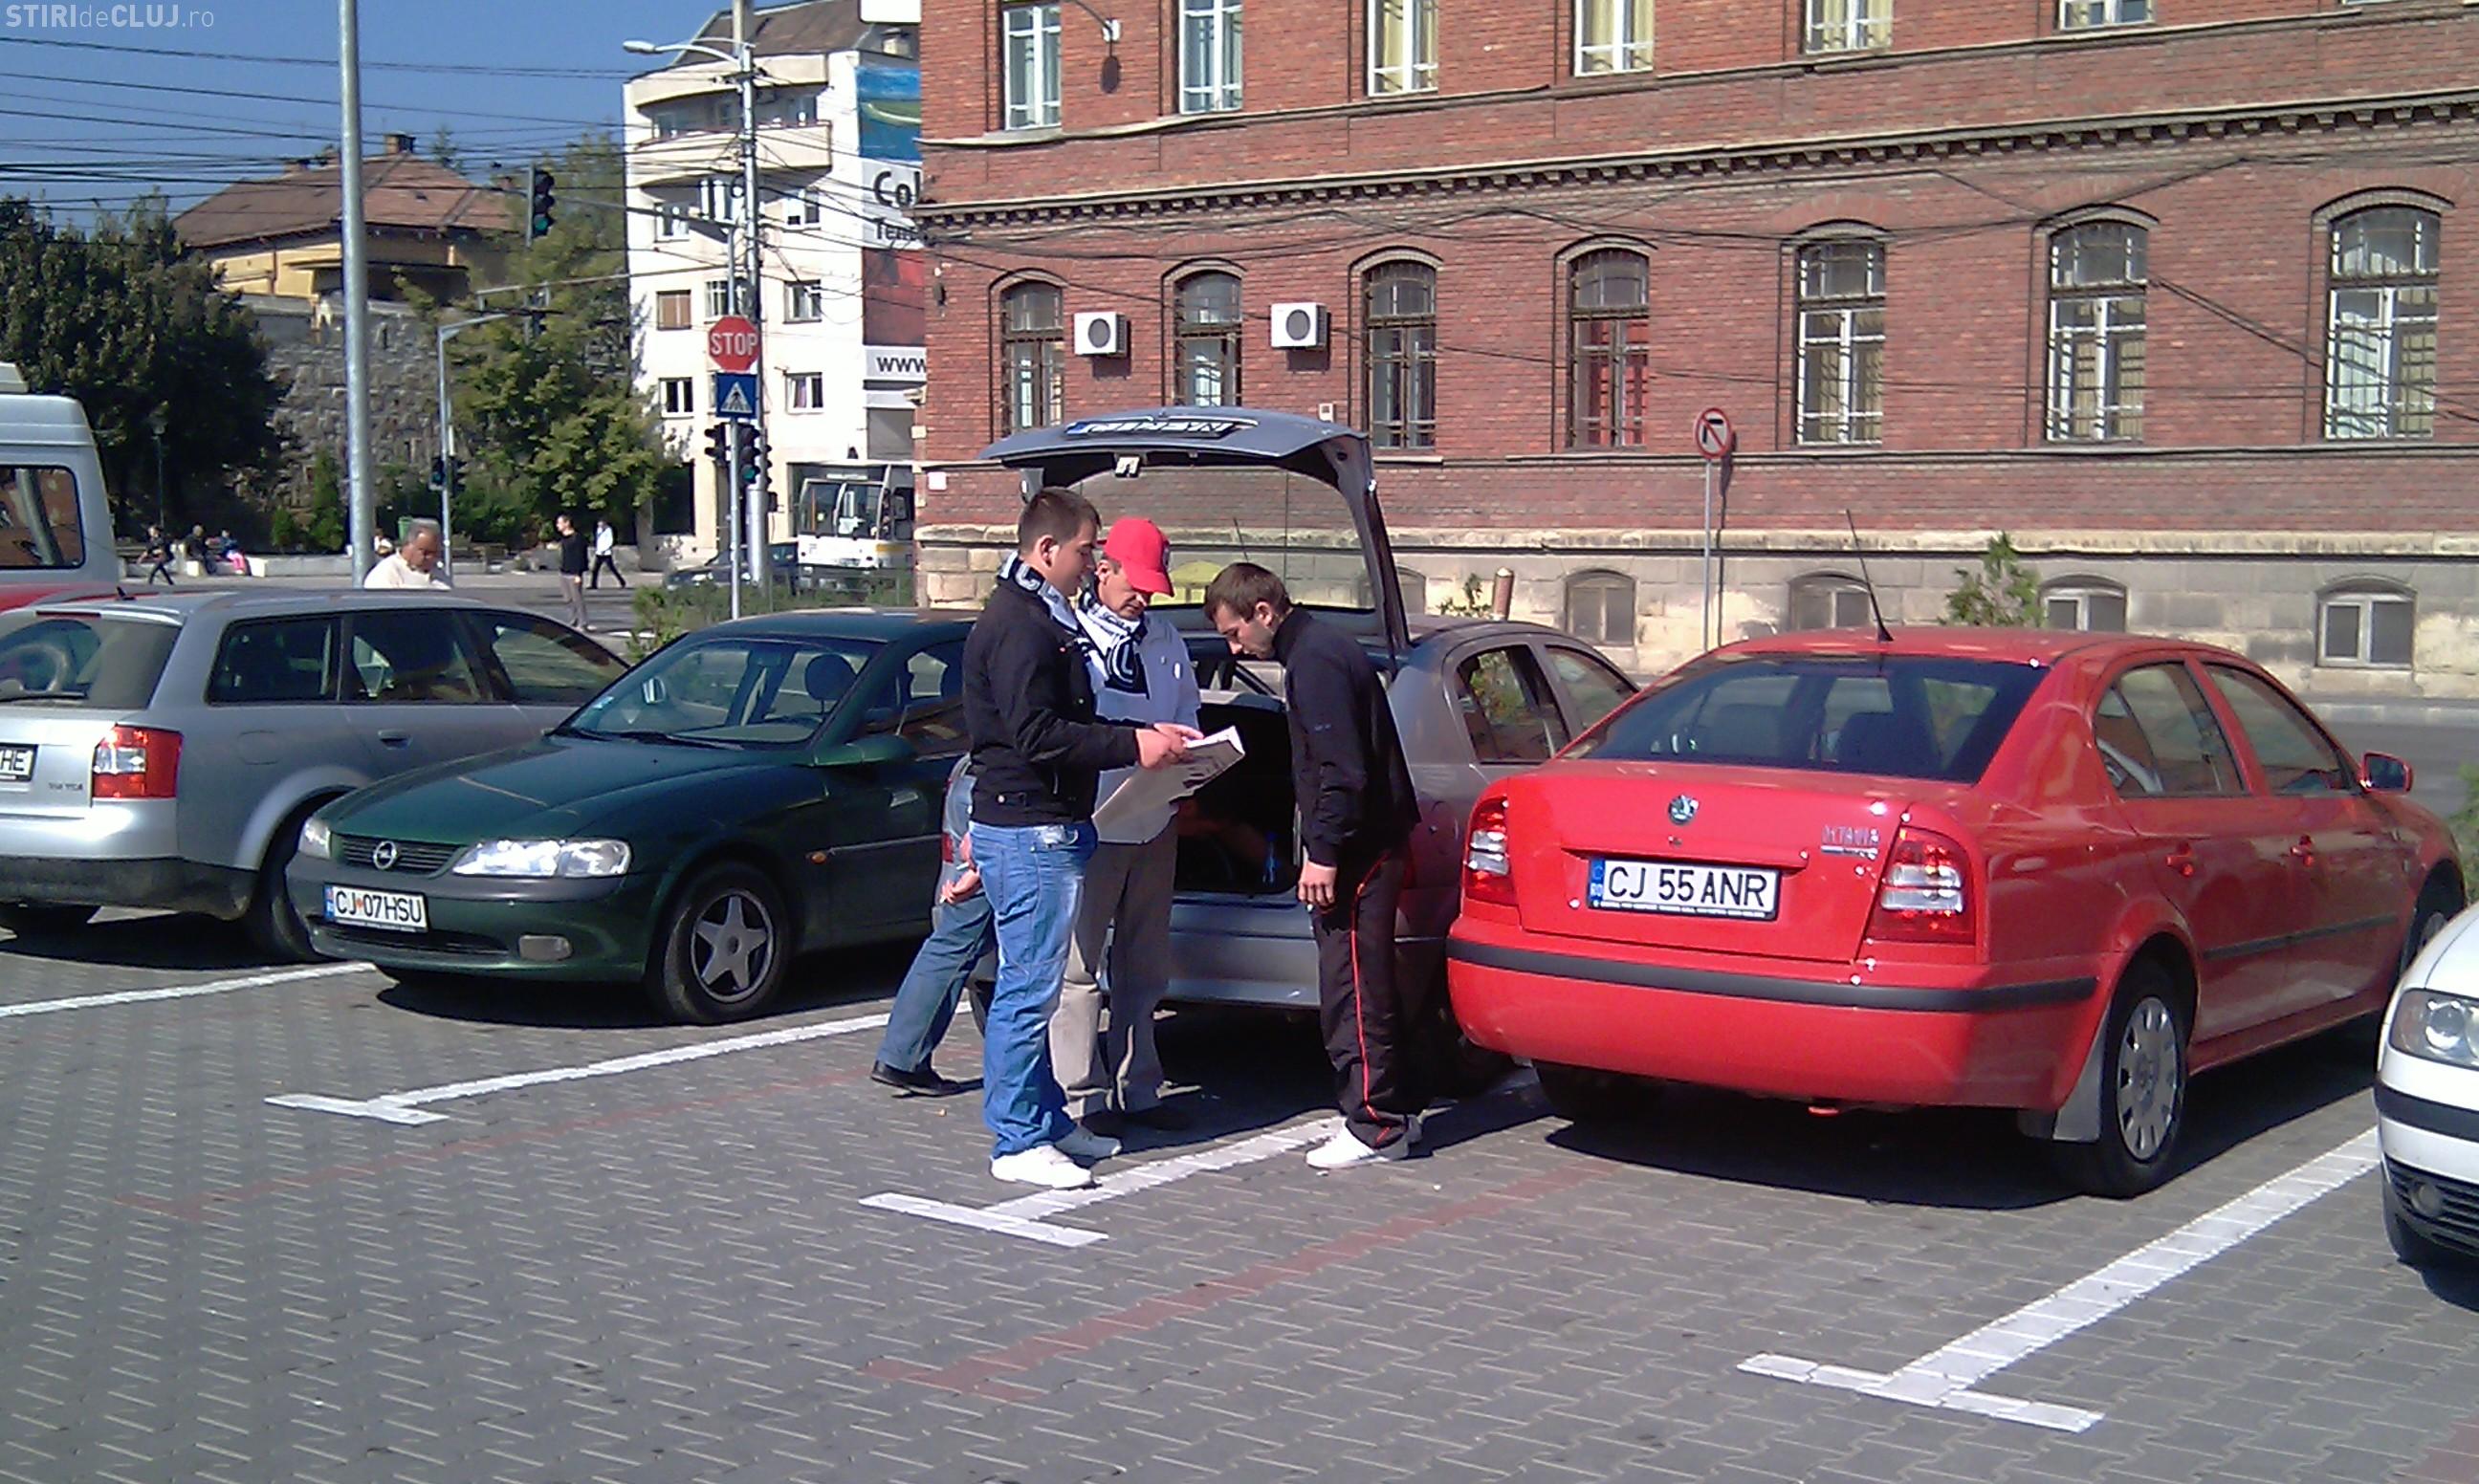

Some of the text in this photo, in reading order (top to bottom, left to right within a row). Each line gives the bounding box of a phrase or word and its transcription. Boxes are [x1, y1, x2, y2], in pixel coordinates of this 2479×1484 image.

[711, 332, 758, 356] STOP
[1609, 866, 1646, 898] CJ
[336, 890, 357, 915] CJ
